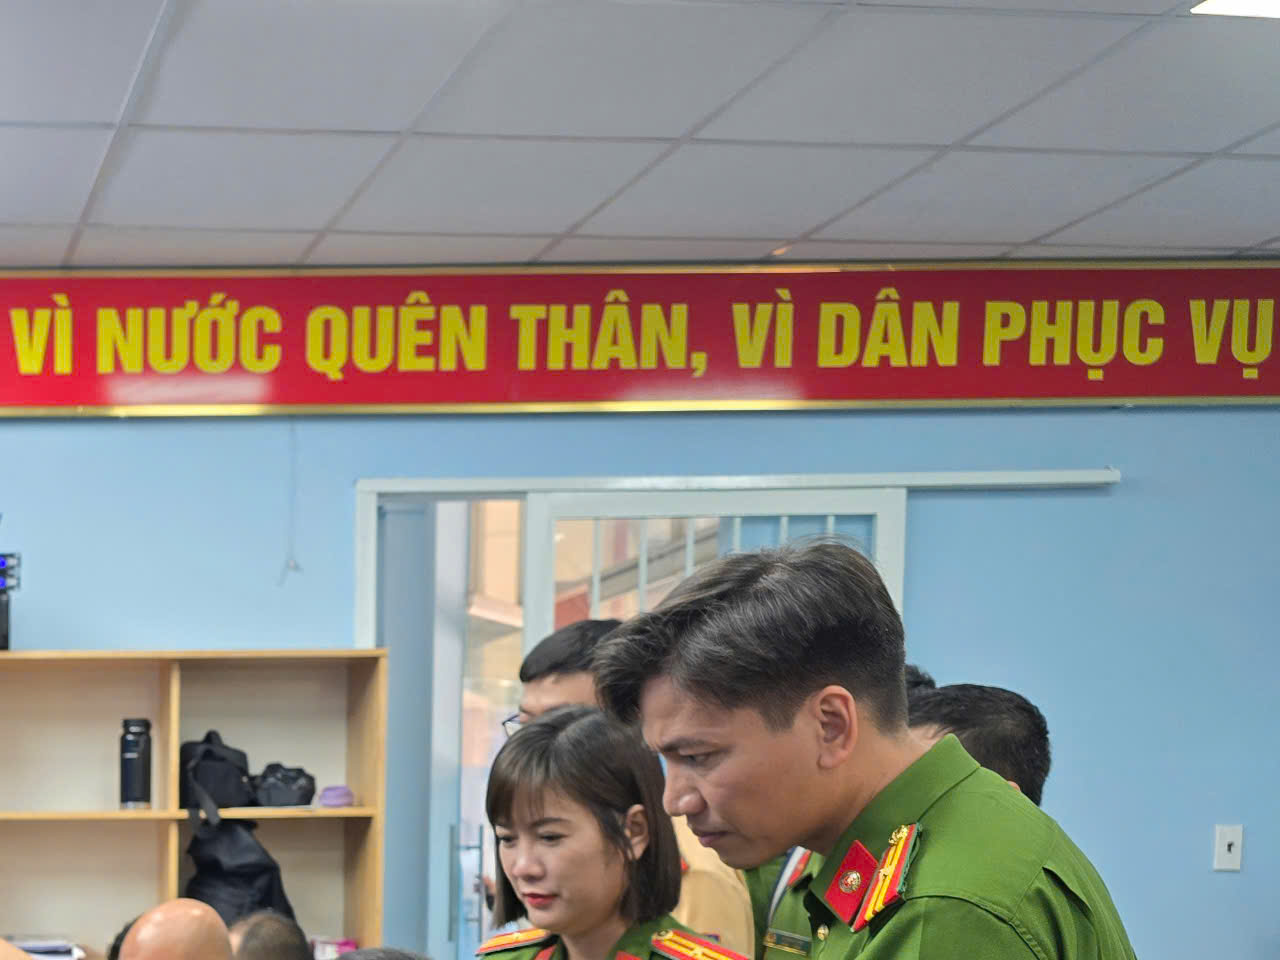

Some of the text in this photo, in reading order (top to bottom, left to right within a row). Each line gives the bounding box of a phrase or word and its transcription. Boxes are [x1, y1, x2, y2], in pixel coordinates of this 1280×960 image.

[10, 293, 74, 375] VÌ
[96, 293, 282, 374] NƯỚC
[306, 290, 487, 380] QUÊN
[509, 289, 708, 378] THÂN,
[732, 288, 794, 369] VÌ
[817, 287, 960, 368] DÂN
[982, 299, 1166, 380] PHỤC
[1190, 298, 1276, 379] VỤ
